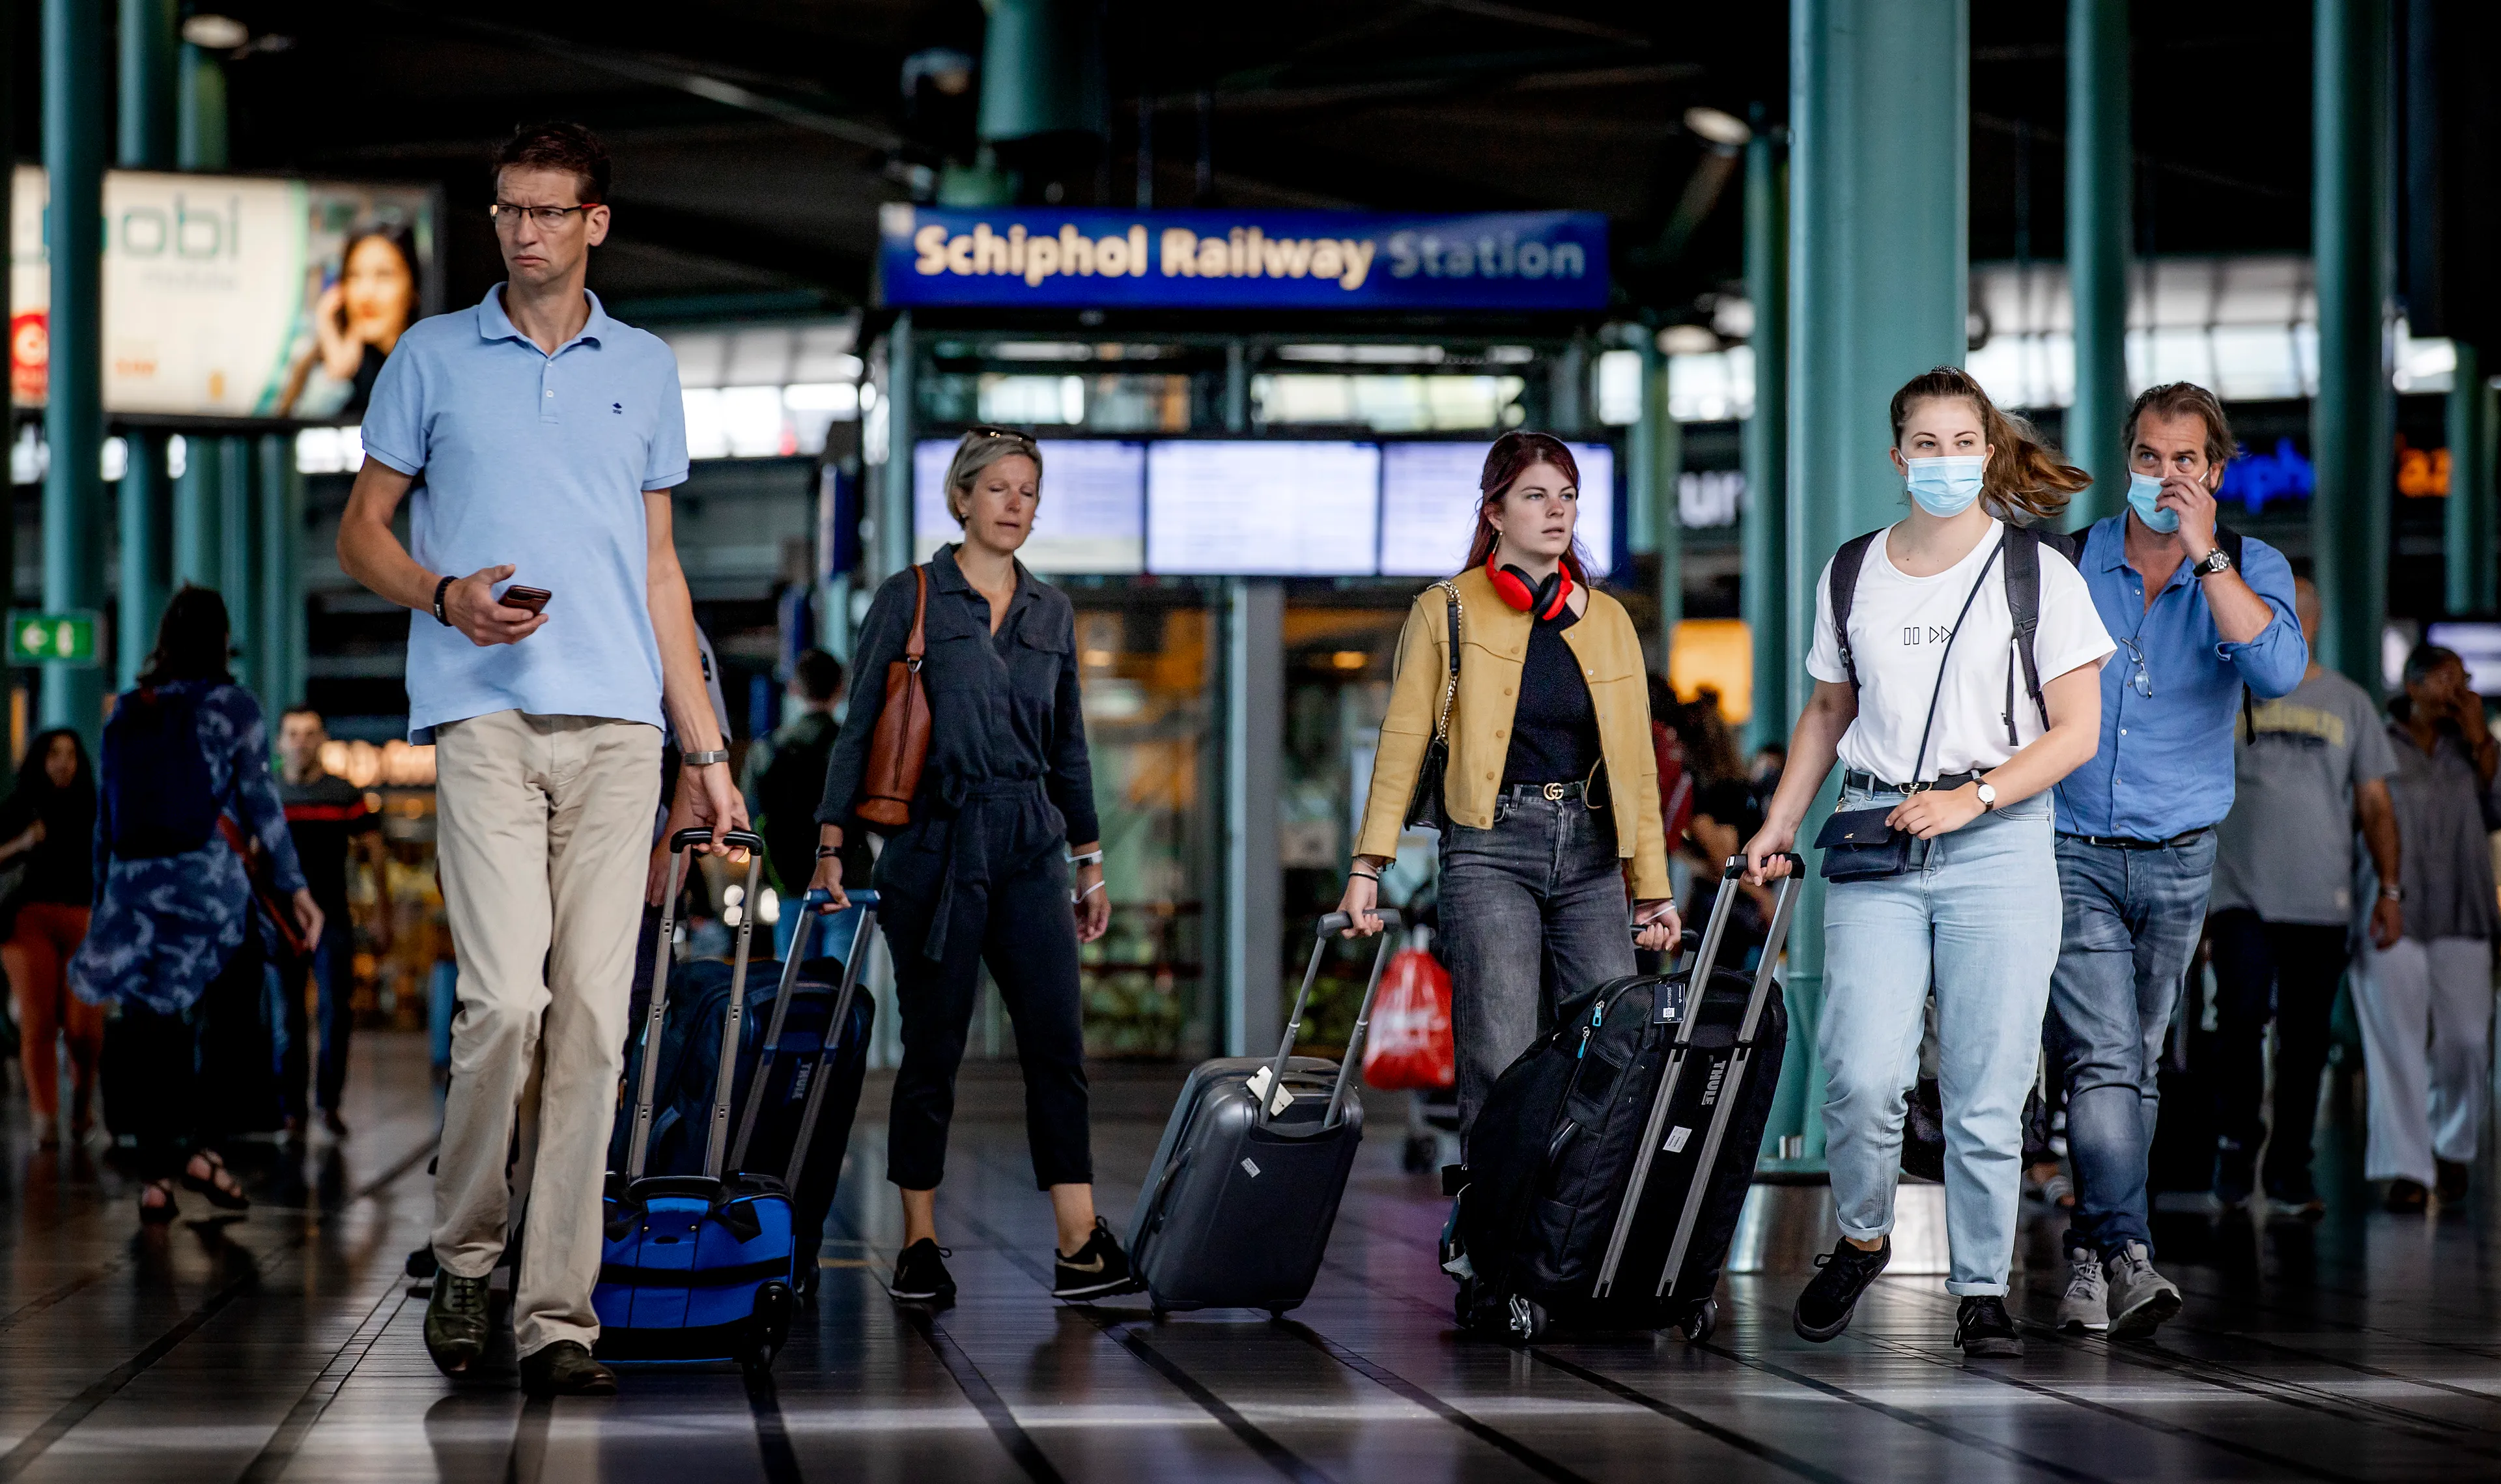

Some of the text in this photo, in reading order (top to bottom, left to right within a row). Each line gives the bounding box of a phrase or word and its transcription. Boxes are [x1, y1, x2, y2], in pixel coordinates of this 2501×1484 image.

[914, 223, 1586, 290] Schiphol Railway Station
[1701, 1060, 1727, 1105] THULE
